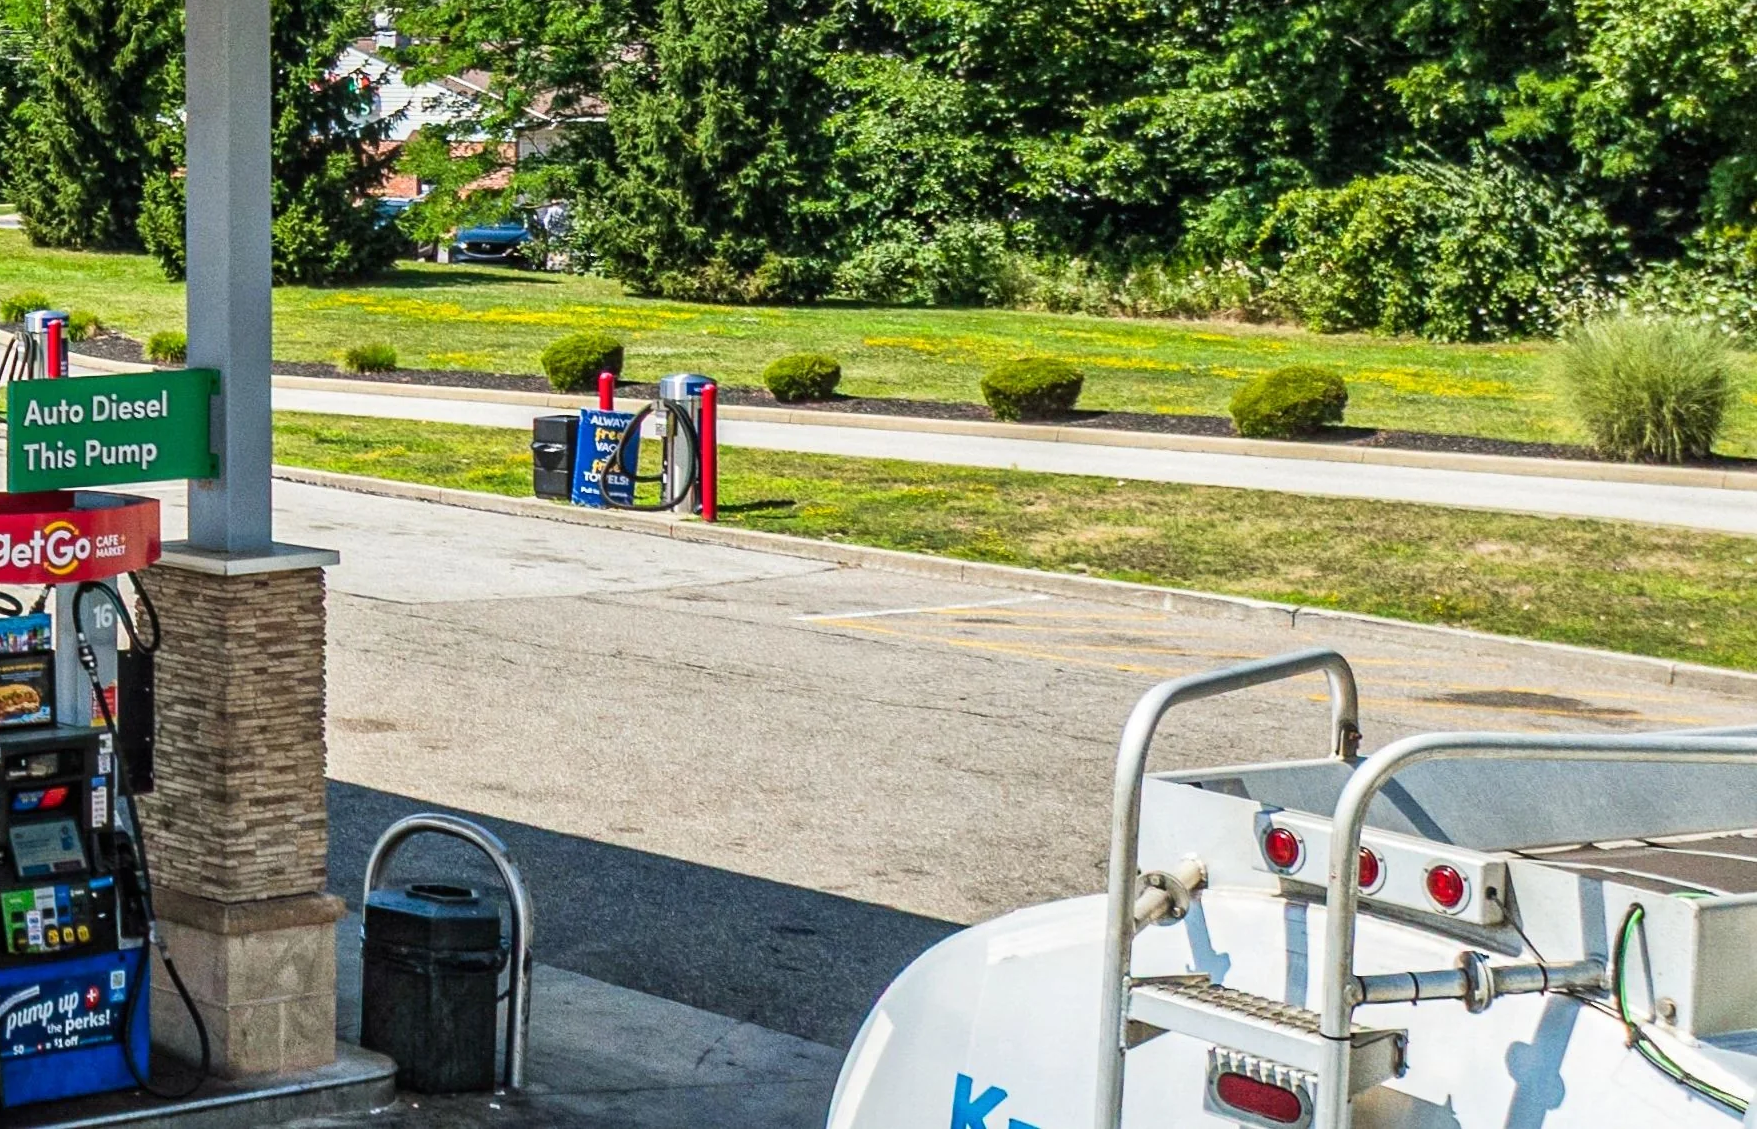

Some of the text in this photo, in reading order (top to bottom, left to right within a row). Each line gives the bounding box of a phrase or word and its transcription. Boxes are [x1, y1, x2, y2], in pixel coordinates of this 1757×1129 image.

[23, 390, 168, 427] Auto Diesel
[23, 440, 158, 470] This Pump
[95, 545, 126, 559] MARKET
[96, 534, 119, 547] CAFE
[93, 603, 113, 628] 16
[6, 1000, 54, 1040] pump
[58, 991, 79, 1018] up
[47, 1009, 111, 1035] the perks!
[65, 1036, 79, 1048] off
